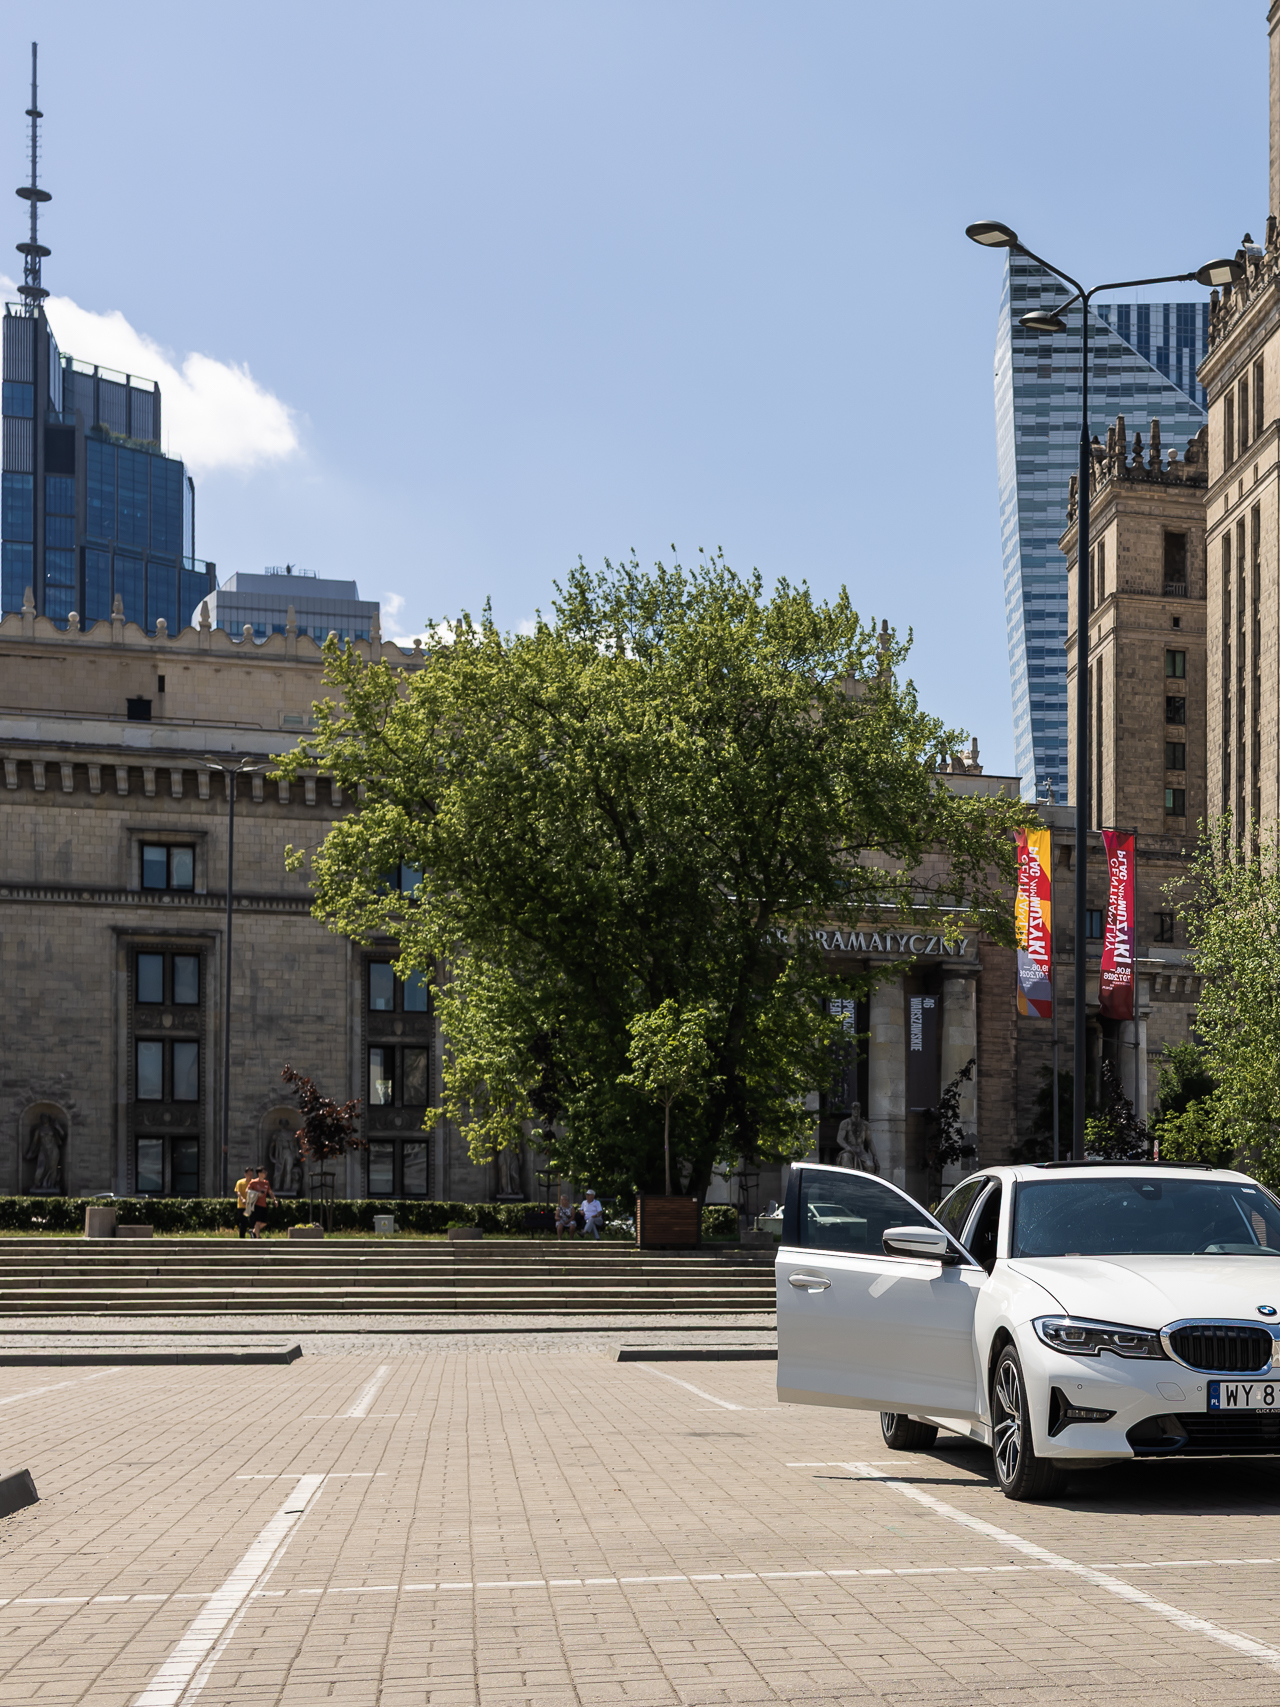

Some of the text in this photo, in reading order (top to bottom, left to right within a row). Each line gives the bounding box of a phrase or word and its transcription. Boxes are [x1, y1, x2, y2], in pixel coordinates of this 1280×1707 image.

[923, 997, 935, 1009] 46
[910, 997, 923, 1052] WARSZAWSKIE
[1211, 1398, 1219, 1406] PL
[1225, 1384, 1254, 1407] WY
